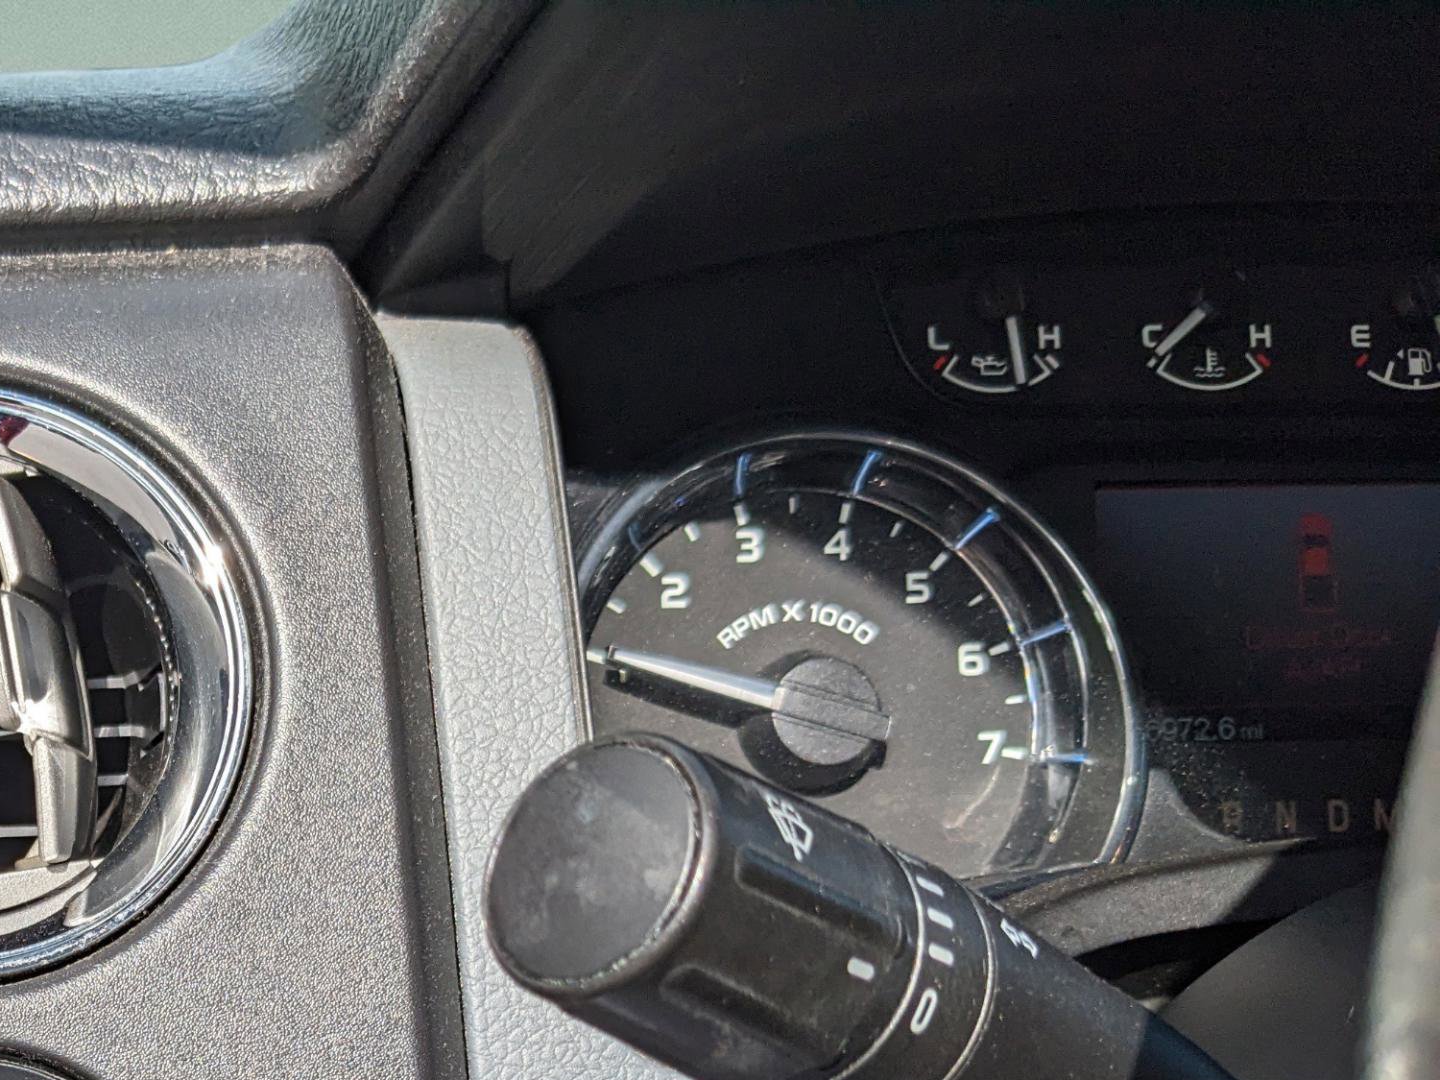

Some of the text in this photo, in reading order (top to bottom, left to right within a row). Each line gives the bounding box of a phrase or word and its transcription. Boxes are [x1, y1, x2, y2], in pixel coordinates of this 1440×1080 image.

[927, 325, 950, 351] L
[1038, 325, 1061, 350] H
[1250, 324, 1272, 349] H
[1350, 324, 1372, 348] E
[735, 526, 766, 564] 3
[823, 526, 853, 562] 4
[660, 573, 690, 609] 2
[905, 570, 934, 605] 5
[716, 603, 779, 650] RPM
[810, 600, 881, 645] 1000
[957, 641, 991, 678] 6
[977, 730, 1009, 766] 7
[1275, 800, 1297, 831] N
[1327, 799, 1351, 832] D
